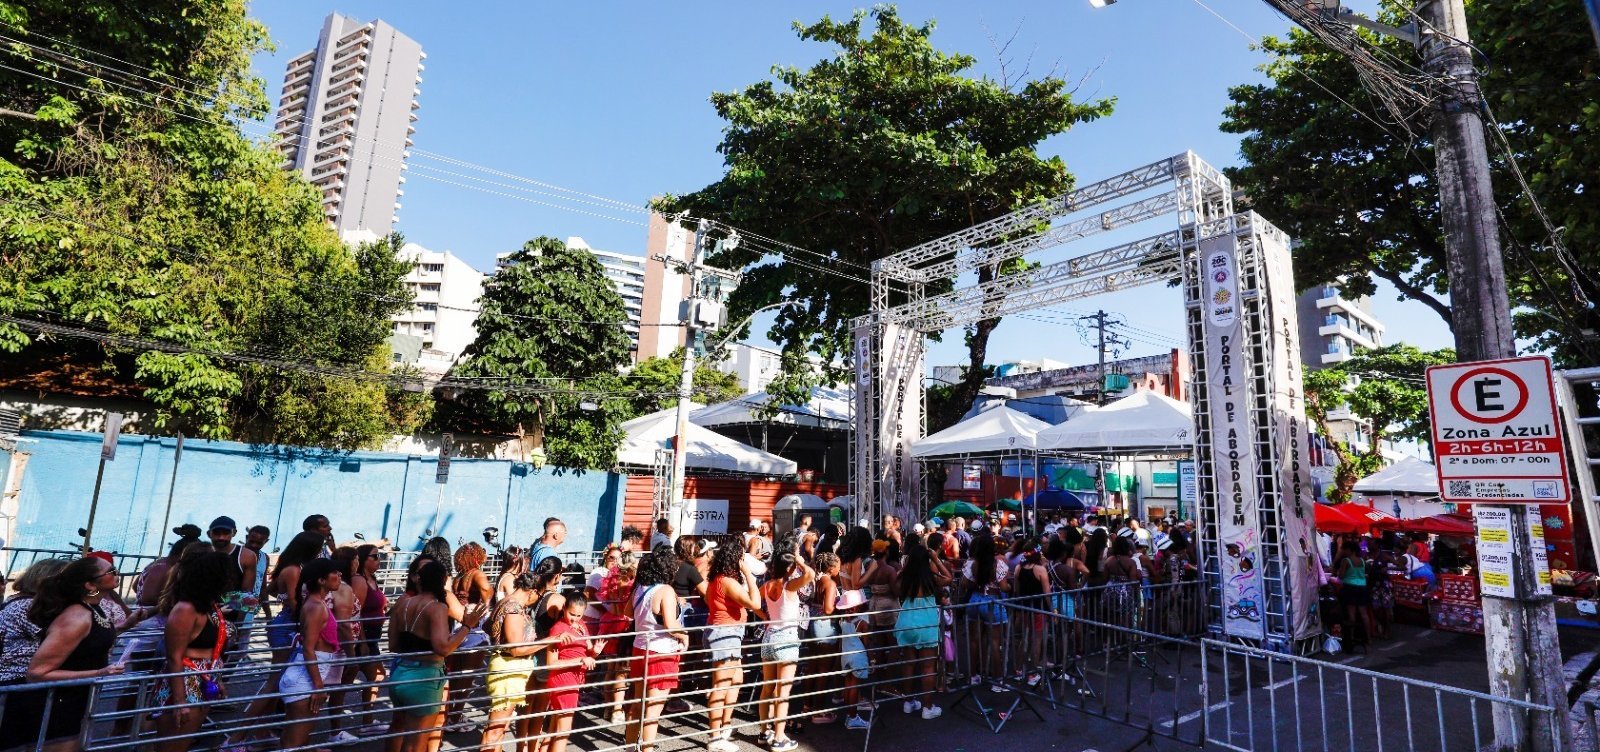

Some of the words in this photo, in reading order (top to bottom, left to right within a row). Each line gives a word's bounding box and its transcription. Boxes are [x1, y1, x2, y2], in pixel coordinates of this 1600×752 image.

[1282, 318, 1294, 381] PORTAL
[1221, 335, 1232, 396] PORTAL
[897, 378, 905, 420] PORTAL
[1288, 389, 1296, 410] DE
[1474, 380, 1504, 411] E
[1225, 402, 1234, 423] DE
[896, 424, 903, 439] DE
[1442, 428, 1491, 439] Zona
[1501, 424, 1551, 437] Azul
[1449, 440, 1546, 454] 2h-6h-12h
[1290, 415, 1304, 518] ABORDAGEM
[1500, 456, 1516, 464] 07
[1228, 428, 1245, 526] ABORDAGEM
[686, 510, 725, 520] VESTRA
